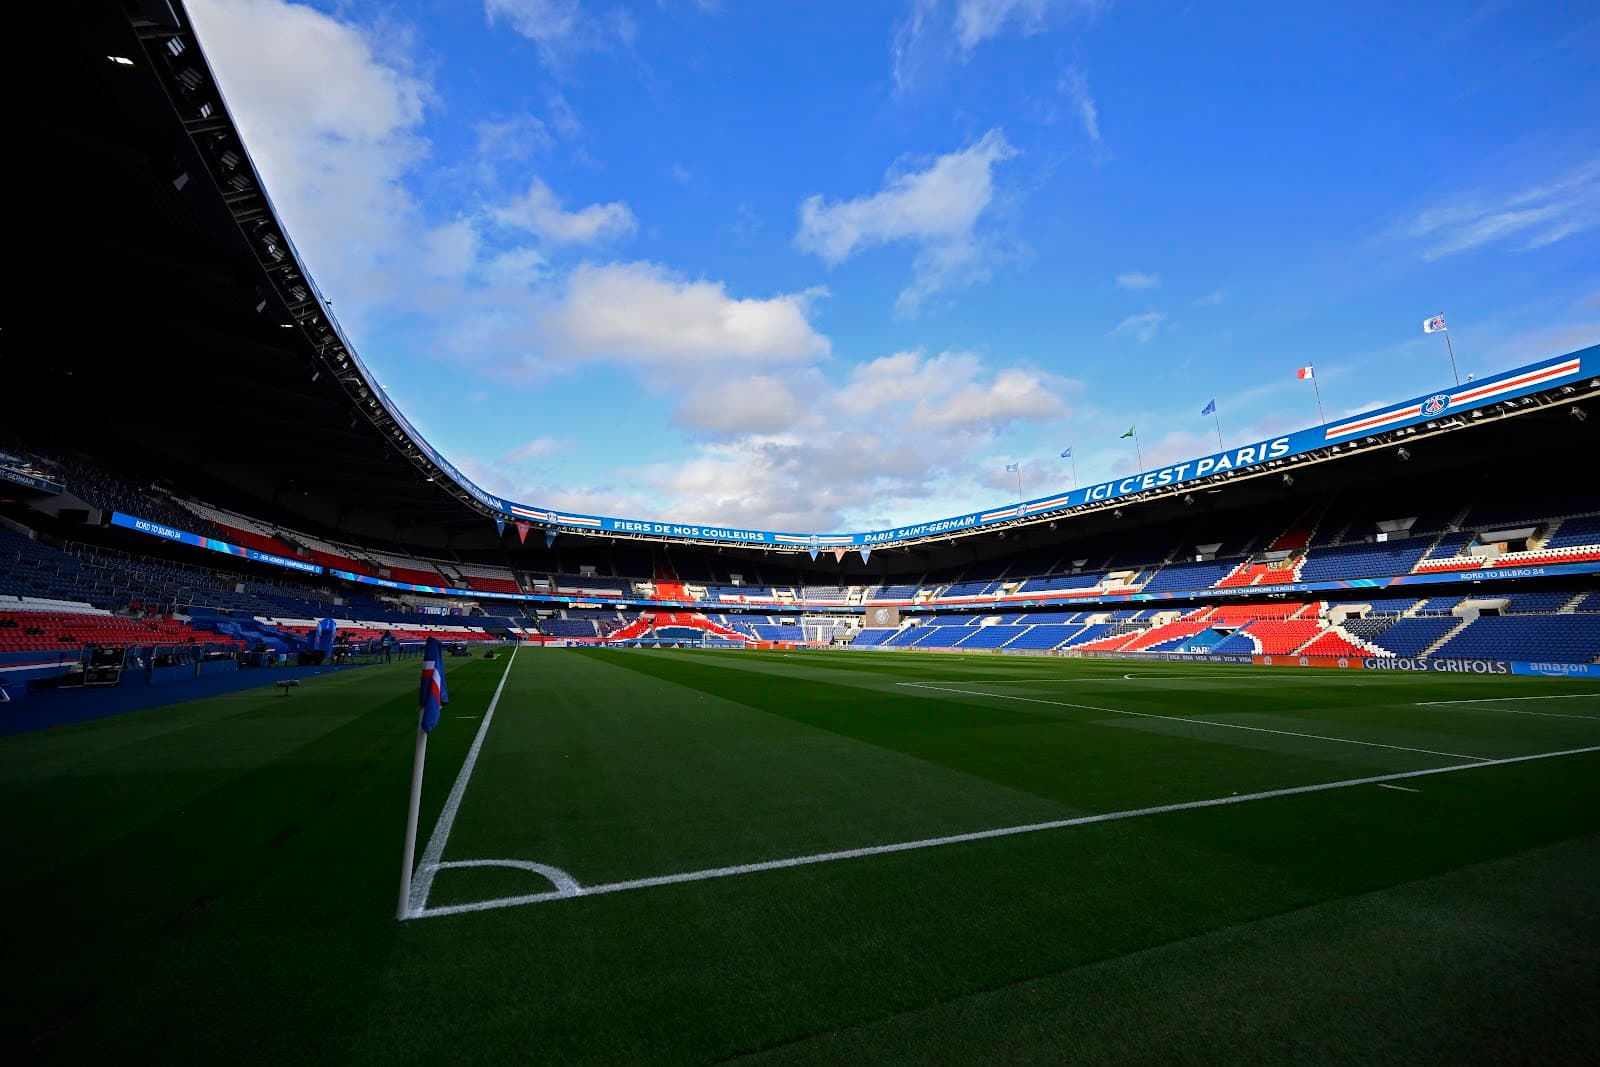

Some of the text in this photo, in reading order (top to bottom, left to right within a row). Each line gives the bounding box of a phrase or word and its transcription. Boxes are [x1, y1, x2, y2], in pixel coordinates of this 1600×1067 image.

[1085, 437, 1290, 502] ICI C'EST PARIS
[0, 470, 35, 486] T-GERMAIN
[151, 524, 158, 533] TO
[614, 521, 765, 541] FIERS DE NOS COULEURS
[864, 515, 976, 543] PARIS SAINT-GERMAIN
[1461, 572, 1484, 580] ROAD
[1237, 586, 1273, 594] CHAMPIONS
[1365, 658, 1507, 675] GRIFOLS GRIFOLS
[1530, 662, 1588, 673] amazon
